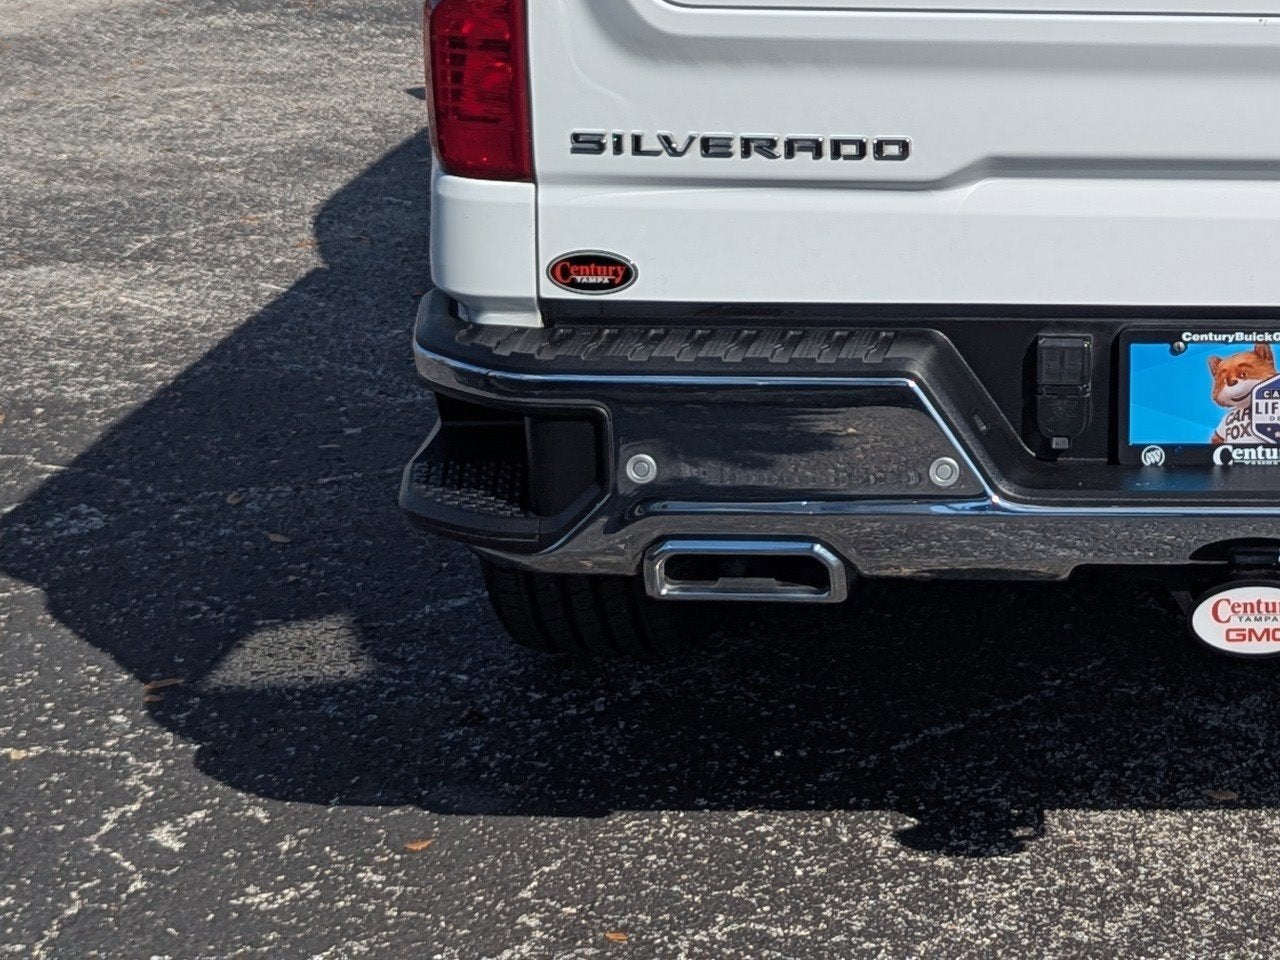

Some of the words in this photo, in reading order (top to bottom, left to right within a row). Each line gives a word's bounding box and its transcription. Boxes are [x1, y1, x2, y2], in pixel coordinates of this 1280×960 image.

[570, 131, 911, 161] SILVERADO
[555, 261, 626, 284] Century
[1225, 422, 1252, 441] FOX
